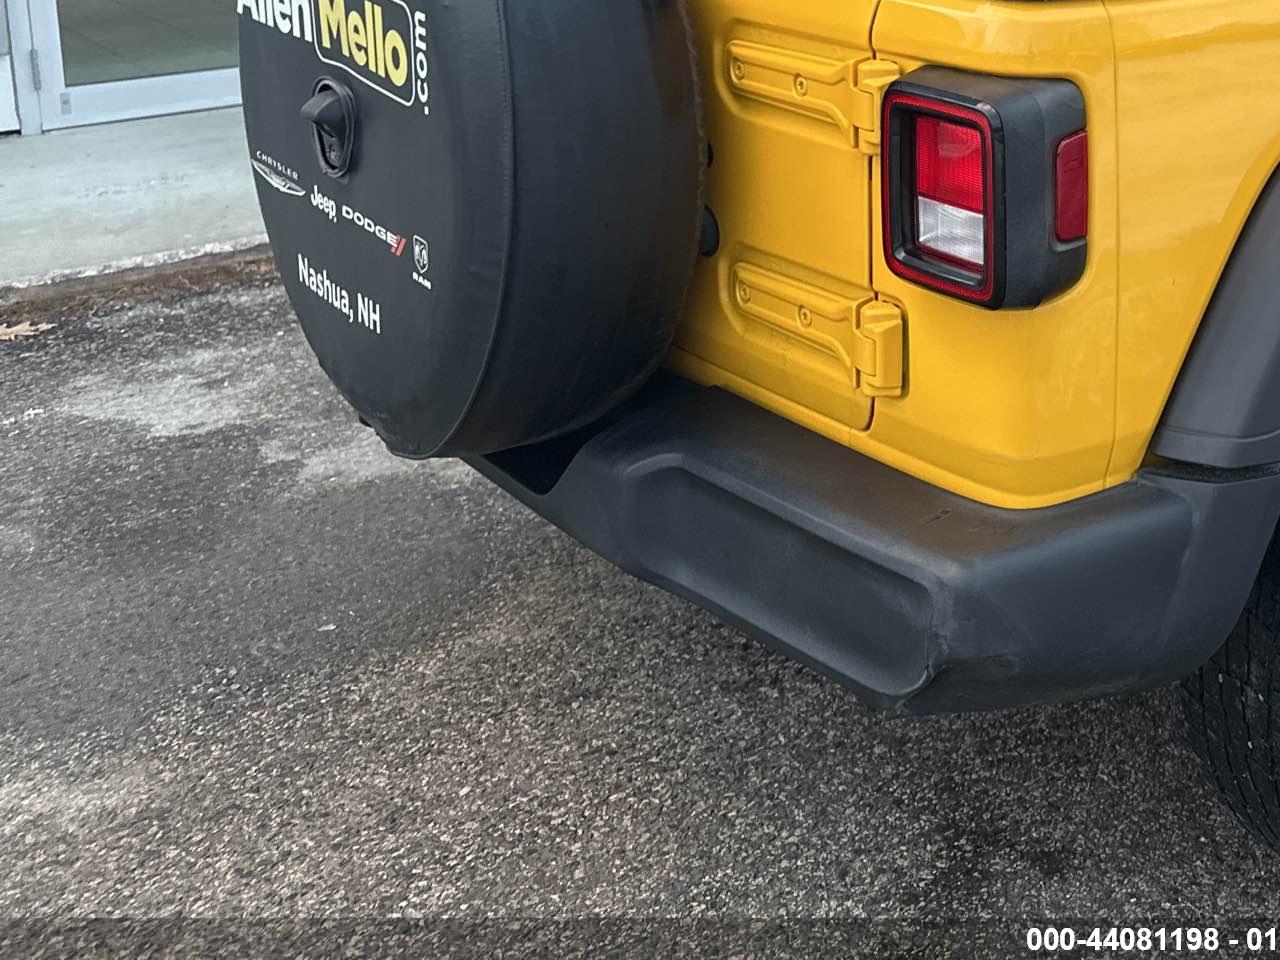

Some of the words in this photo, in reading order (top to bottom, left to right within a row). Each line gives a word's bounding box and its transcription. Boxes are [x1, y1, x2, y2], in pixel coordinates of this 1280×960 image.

[414, 10, 429, 115] .com
[256, 150, 299, 181] CHRYSLER
[341, 205, 399, 248] DODGE
[297, 253, 354, 323] Nashua,
[357, 292, 381, 334] NH
[412, 271, 432, 290] RAM
